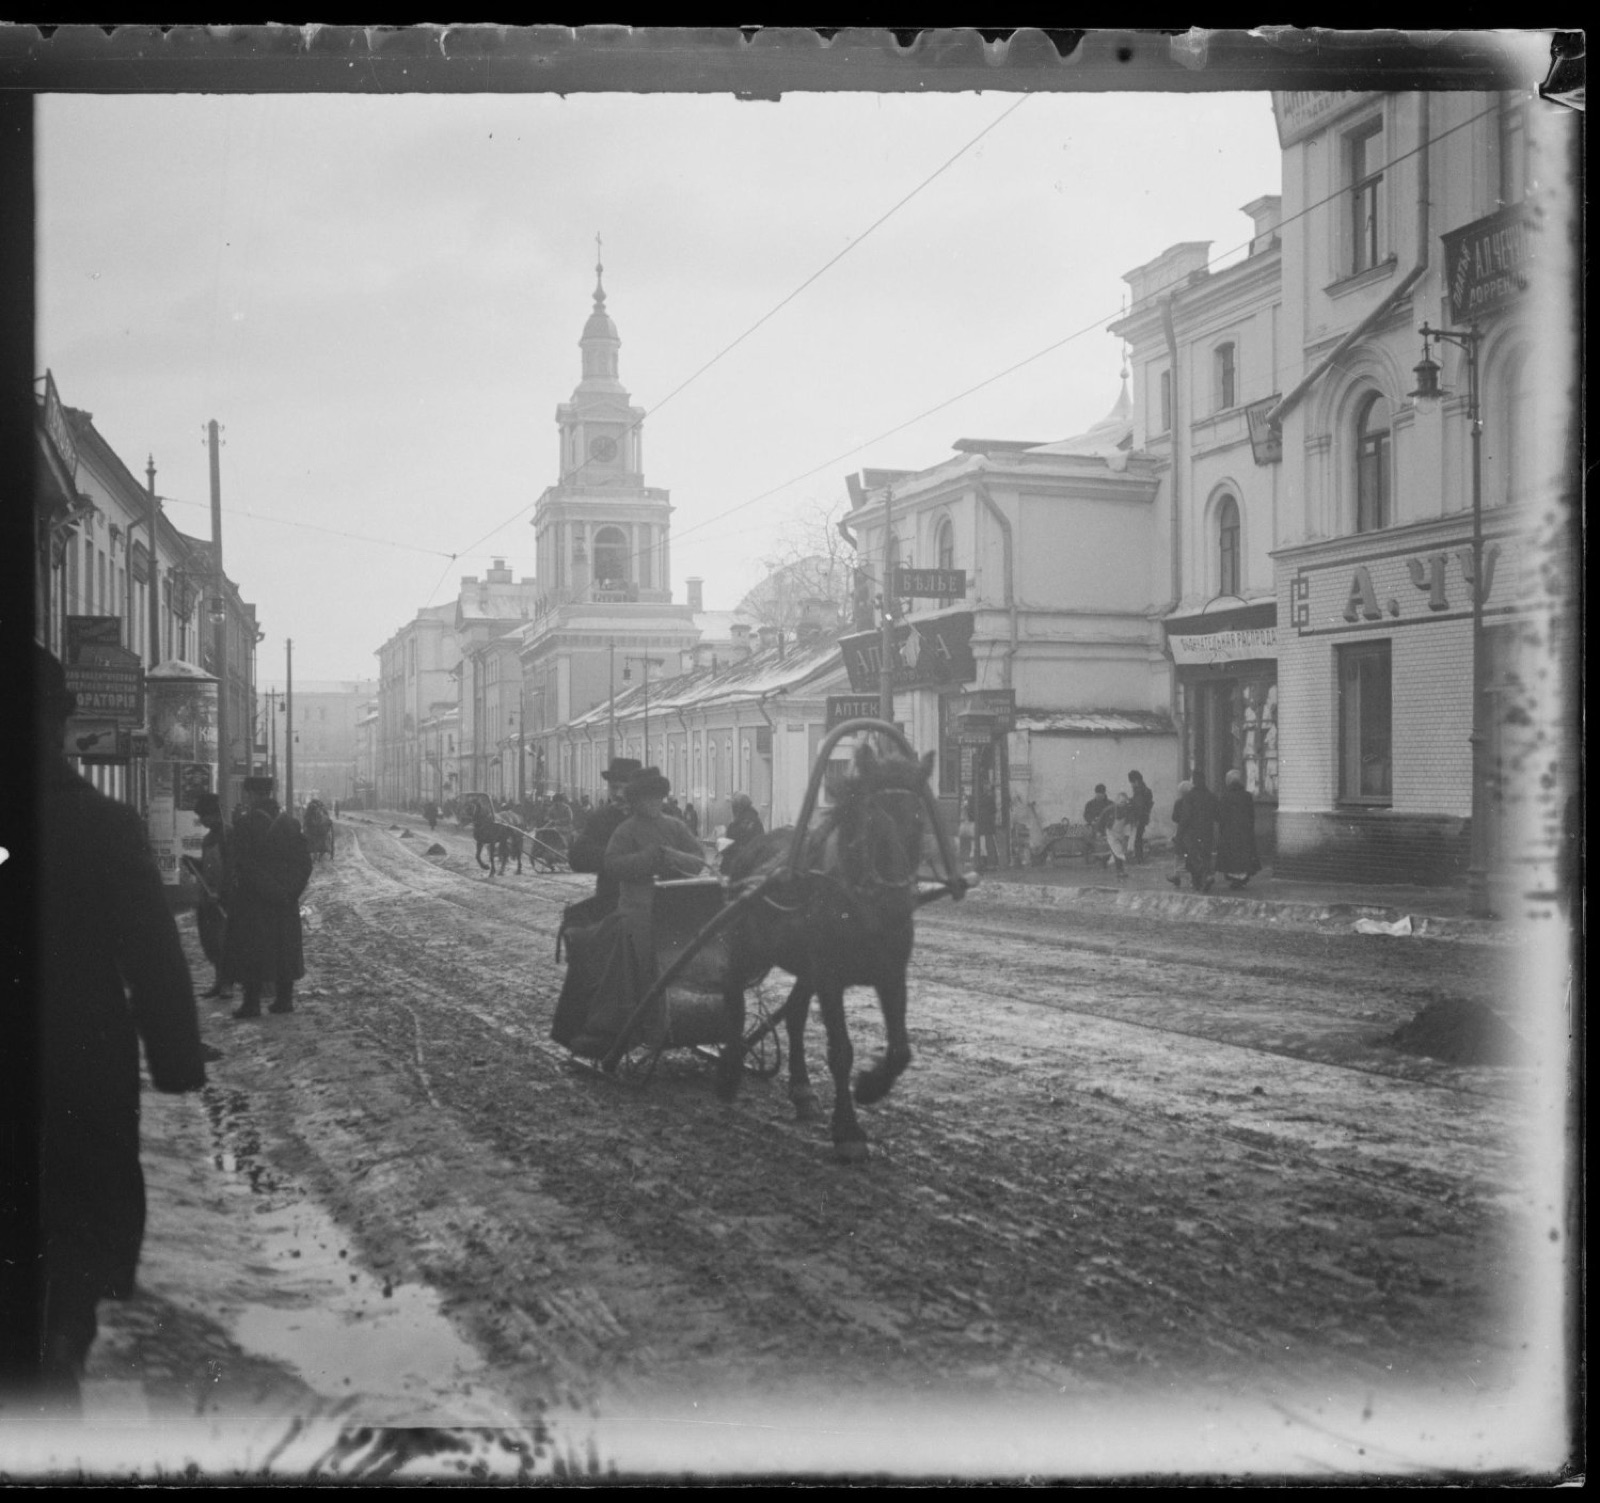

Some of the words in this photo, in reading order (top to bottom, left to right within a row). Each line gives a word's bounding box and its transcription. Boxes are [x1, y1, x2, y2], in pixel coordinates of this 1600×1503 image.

[903, 574, 958, 592] БѢЛЬЕ
[76, 692, 136, 708] ОРАТОРІЯ
[834, 702, 881, 717] АПТЕК
